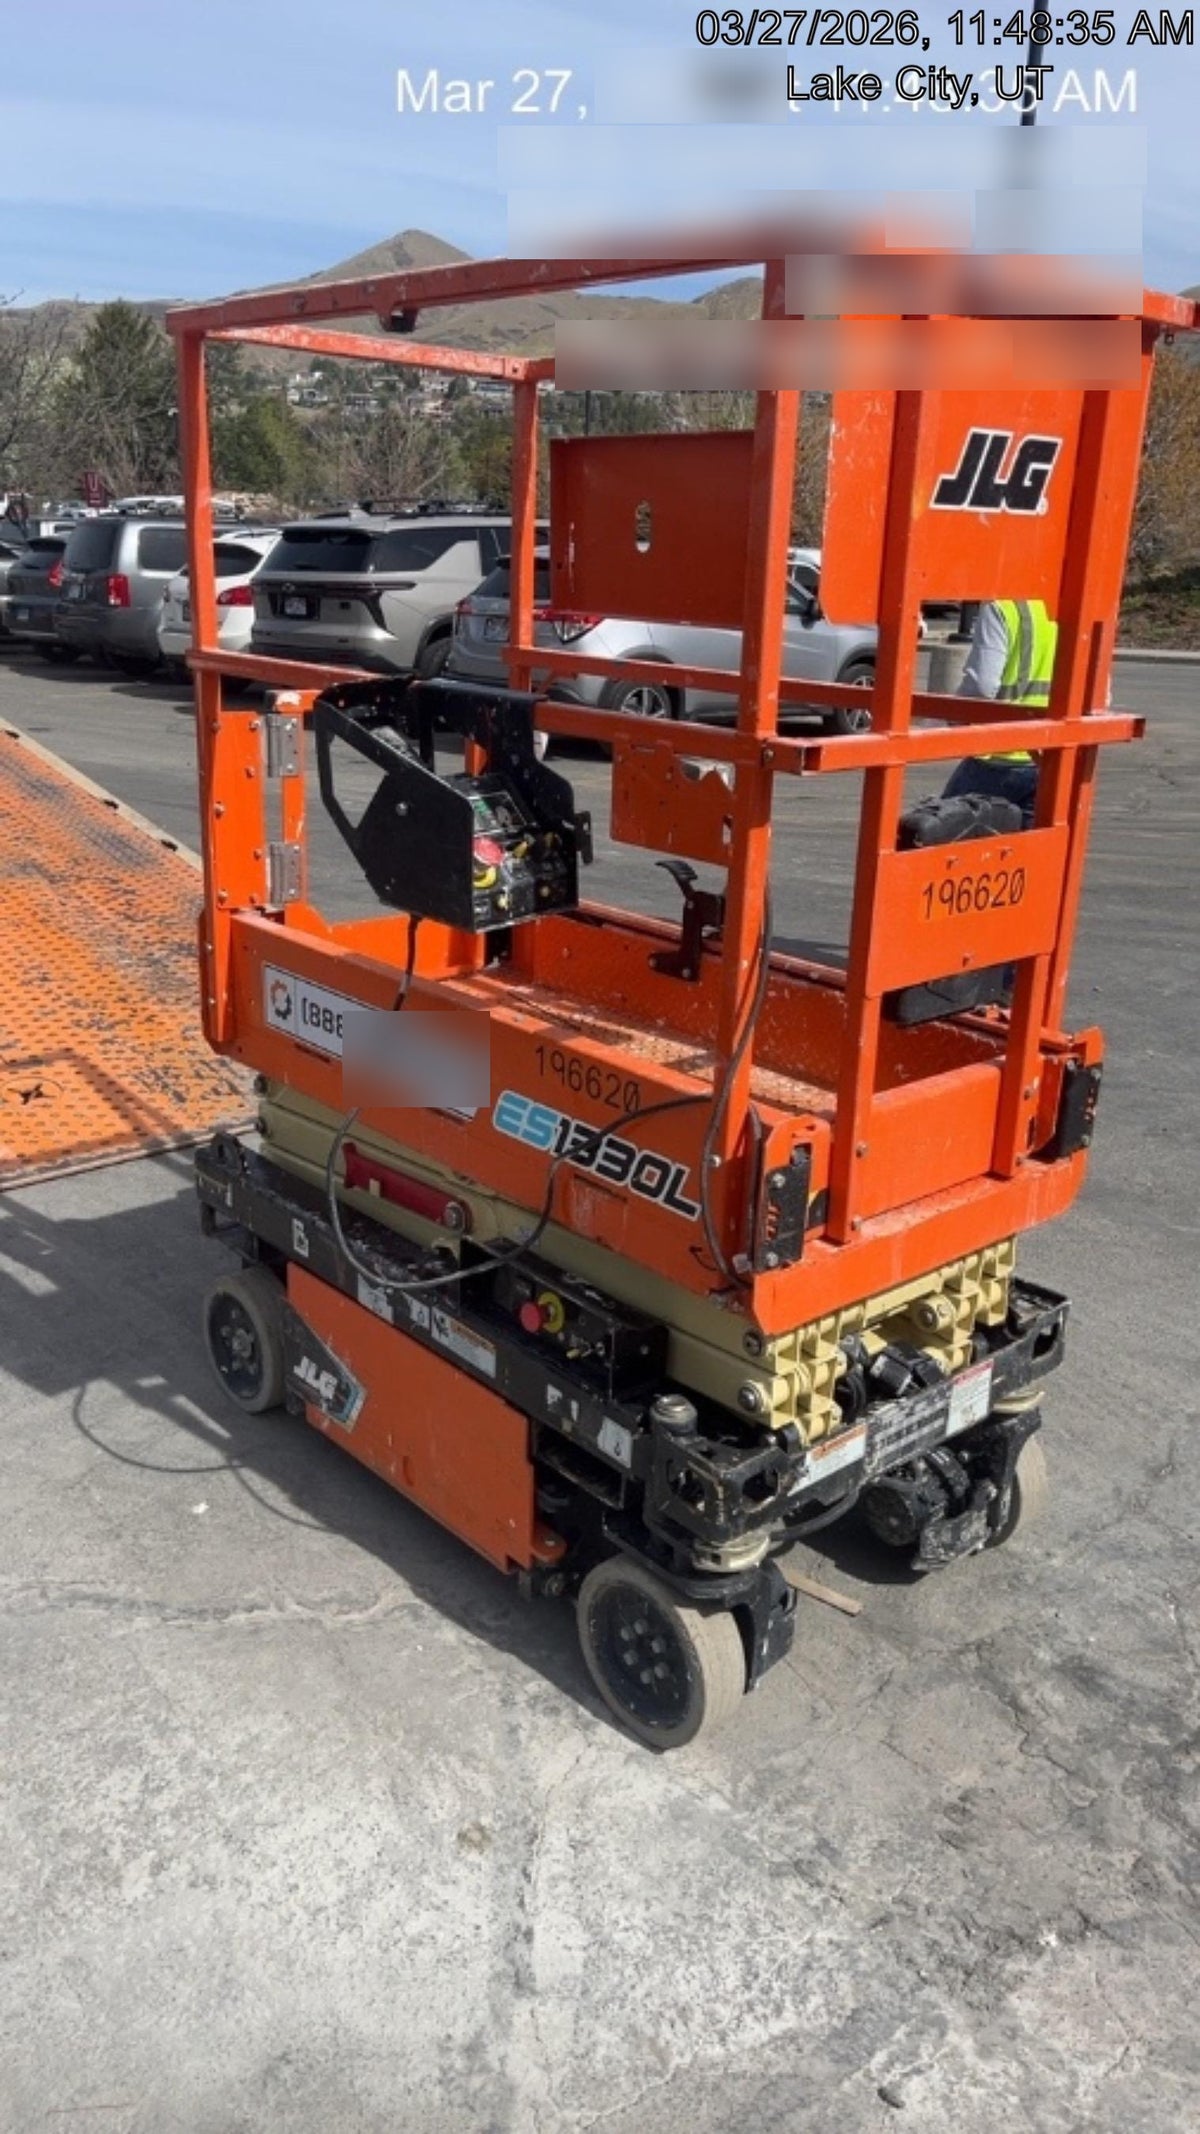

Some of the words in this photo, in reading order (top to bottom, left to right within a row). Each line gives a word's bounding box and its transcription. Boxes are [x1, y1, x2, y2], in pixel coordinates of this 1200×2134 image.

[930, 427, 1062, 515] JLG
[923, 867, 1025, 919] 196620
[535, 1046, 640, 1114] 196620
[493, 1090, 701, 1221] ES1330L
[293, 1355, 338, 1400] JLG
